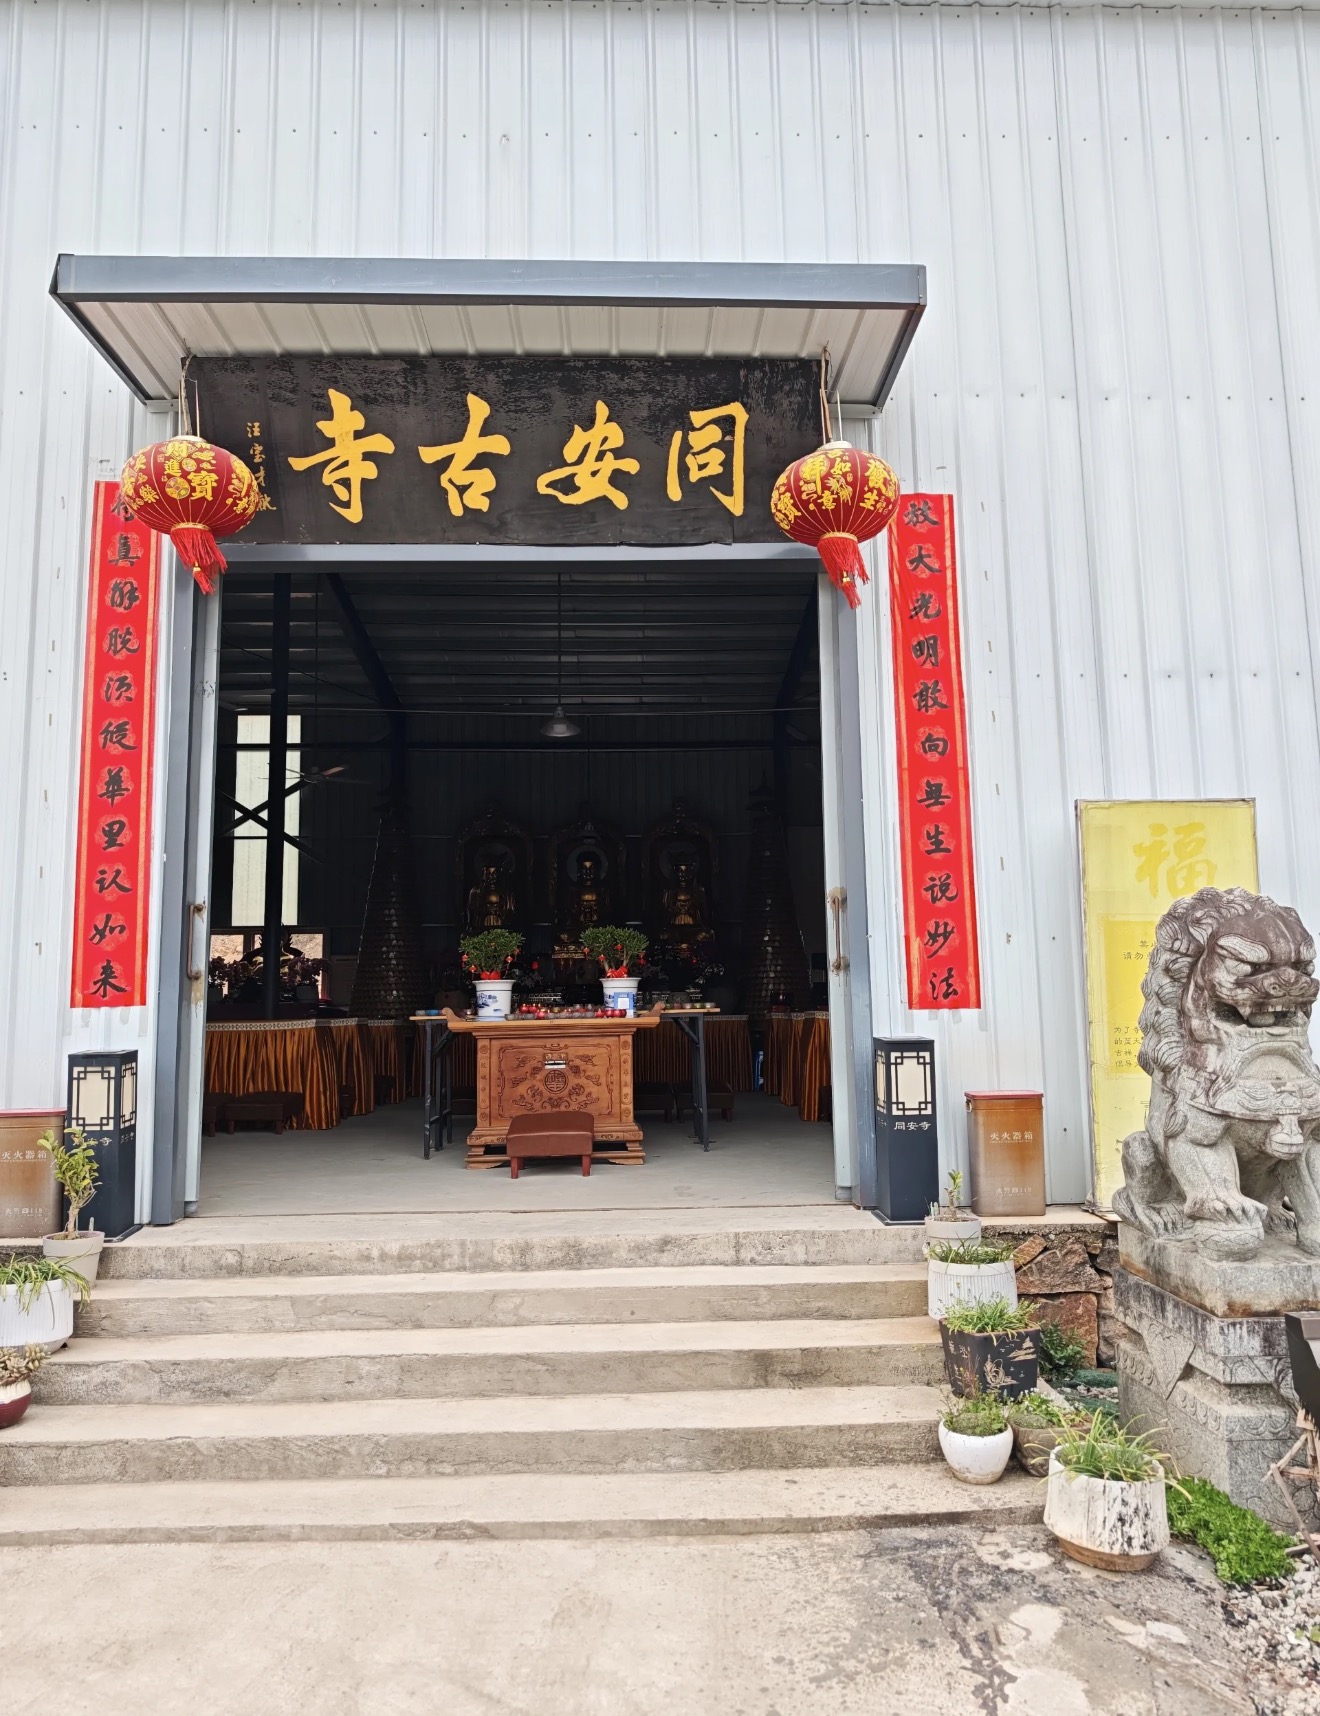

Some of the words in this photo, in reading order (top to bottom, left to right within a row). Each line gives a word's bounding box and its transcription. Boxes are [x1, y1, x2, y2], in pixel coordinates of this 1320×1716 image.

[288, 388, 749, 524] 同安古寺
[1133, 822, 1217, 898] 福
[1123, 951, 1150, 960] 请勿
[894, 1121, 931, 1131] 同安寺
